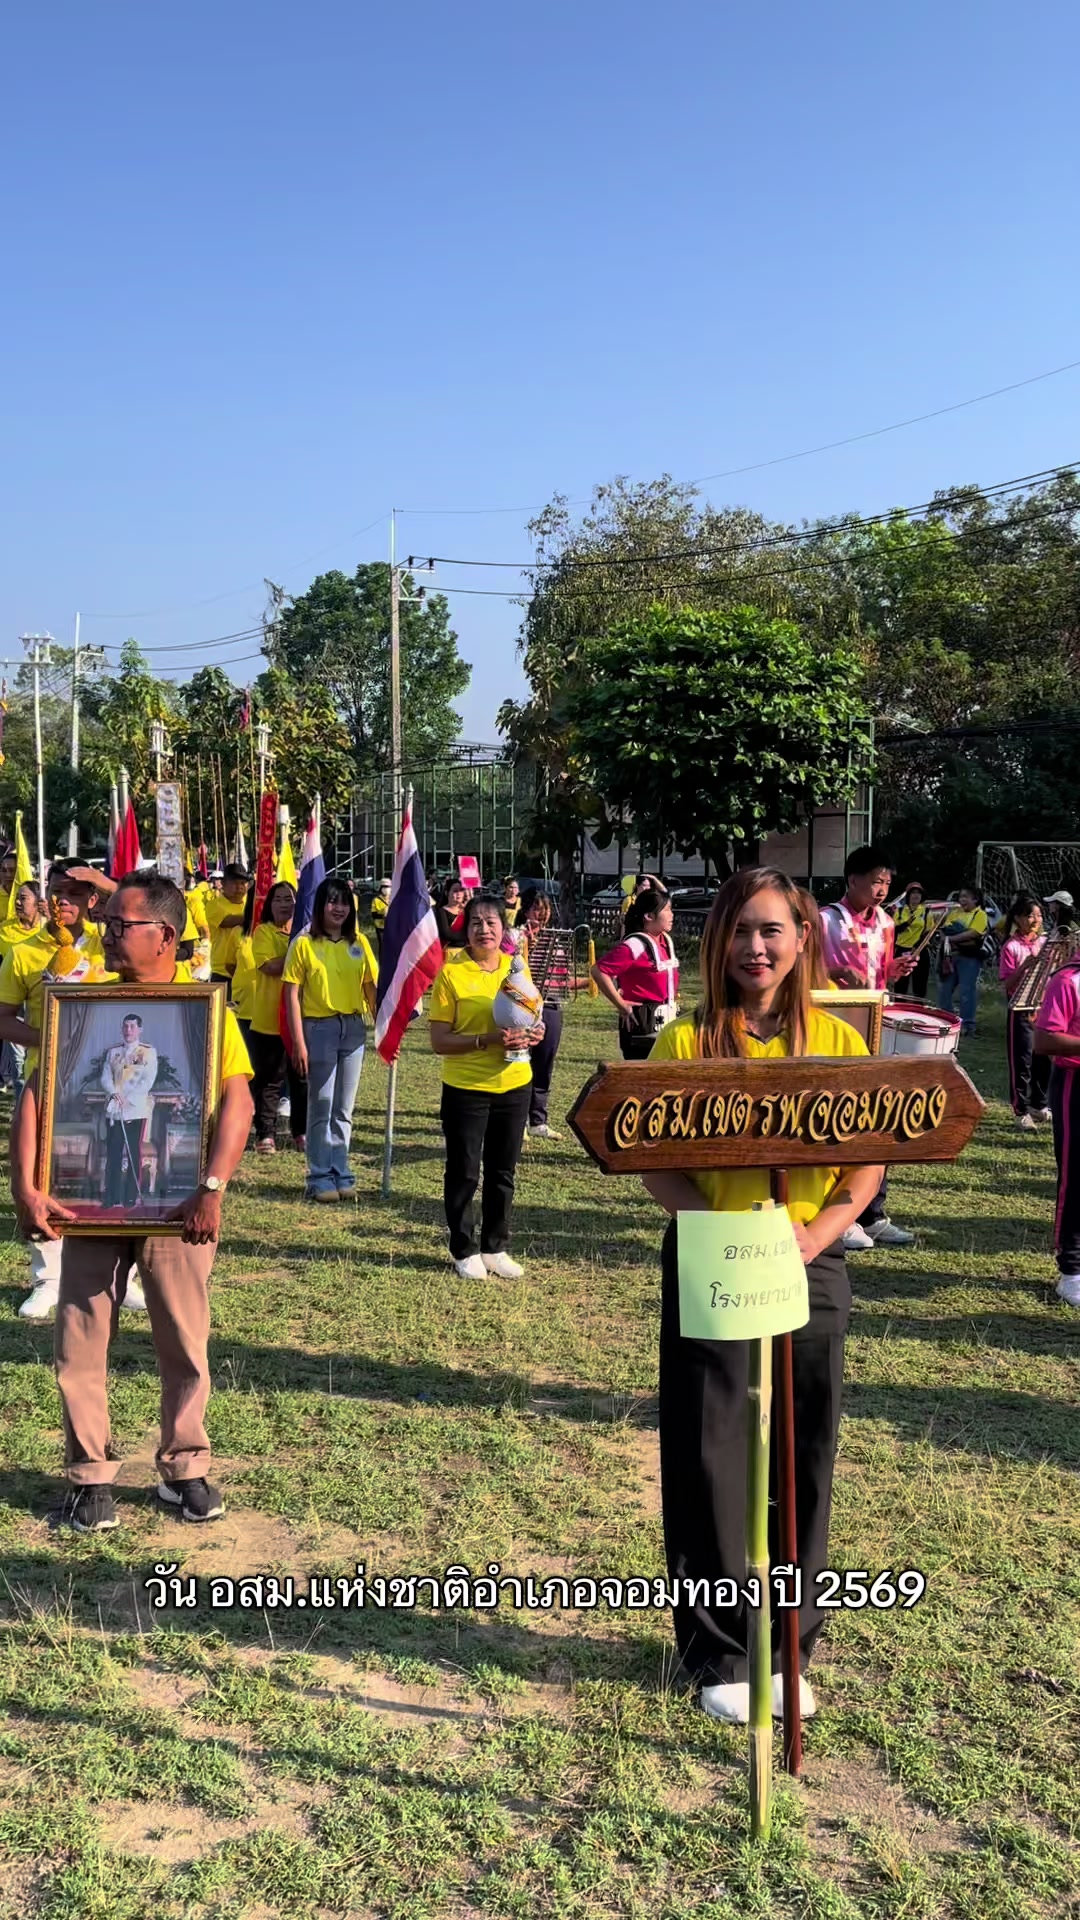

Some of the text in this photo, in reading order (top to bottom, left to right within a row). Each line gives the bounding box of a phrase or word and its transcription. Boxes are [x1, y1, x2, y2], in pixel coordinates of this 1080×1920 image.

[613, 1083, 948, 1149] อสม.เขต รพ.จอมทอง
